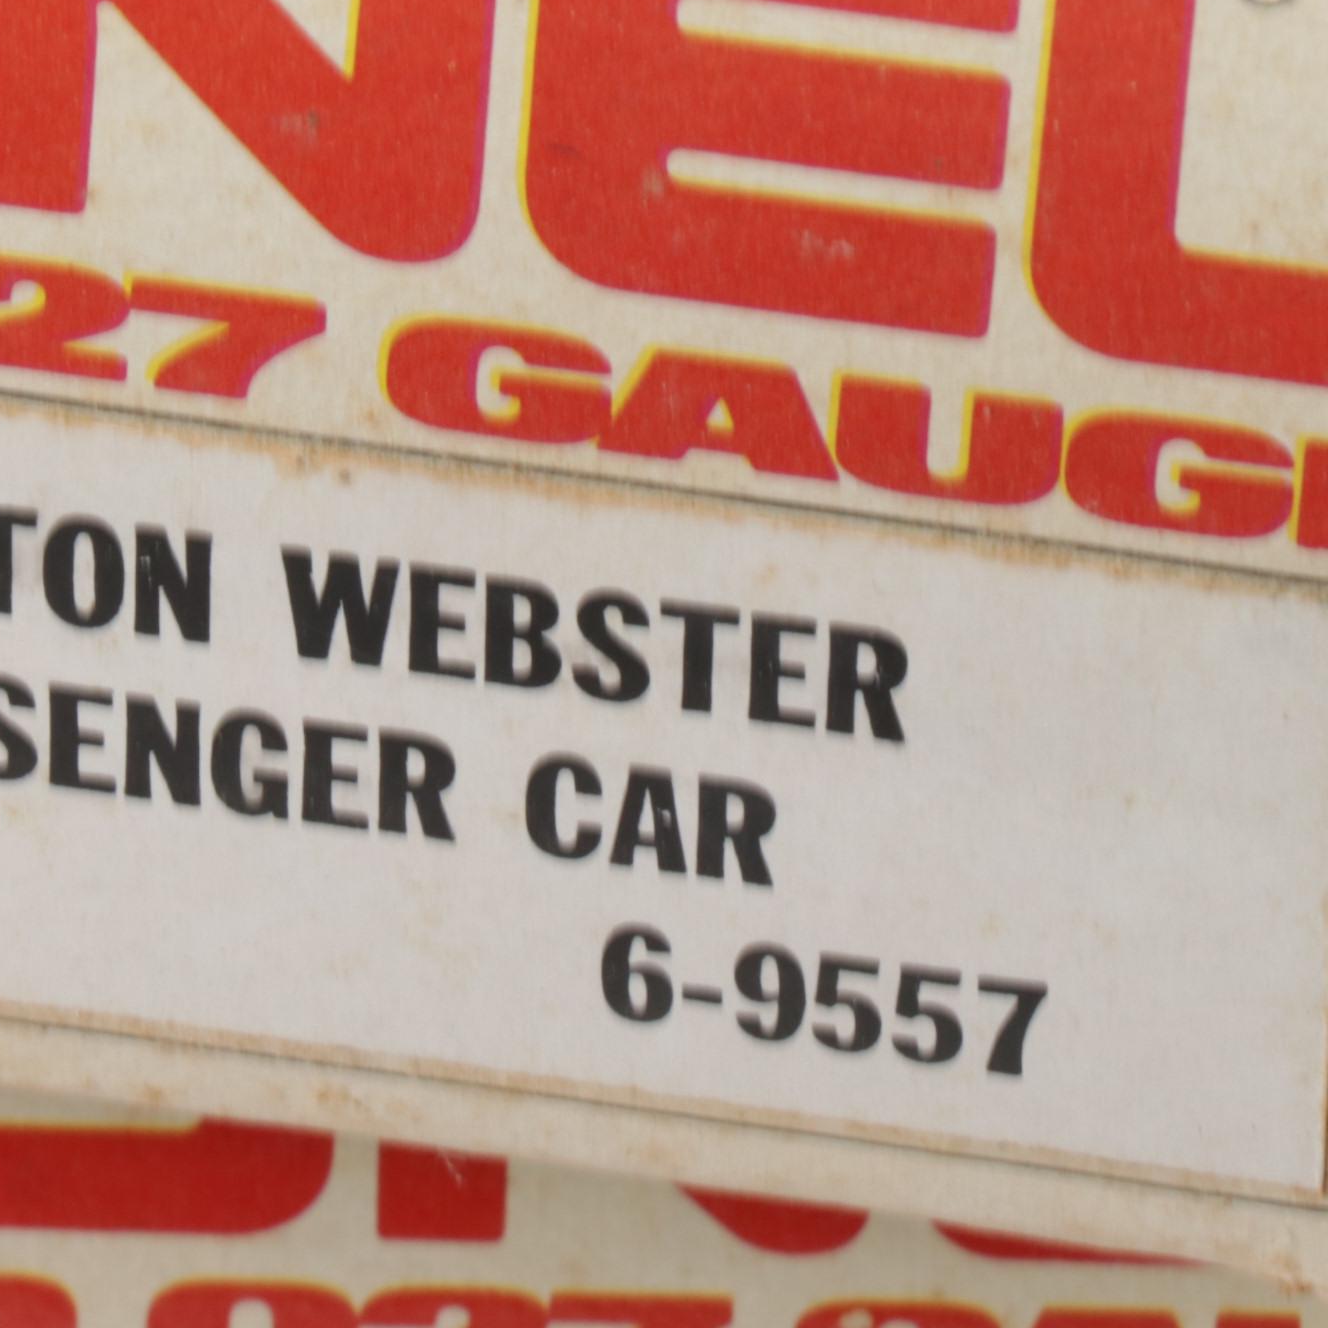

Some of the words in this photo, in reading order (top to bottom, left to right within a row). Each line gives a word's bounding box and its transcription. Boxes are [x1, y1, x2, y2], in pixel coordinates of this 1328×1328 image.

[378, 312, 1328, 550] GAUG
[279, 545, 910, 745] WEBSTER
[523, 752, 779, 889] CAR
[599, 922, 1050, 1078] 6-9557
